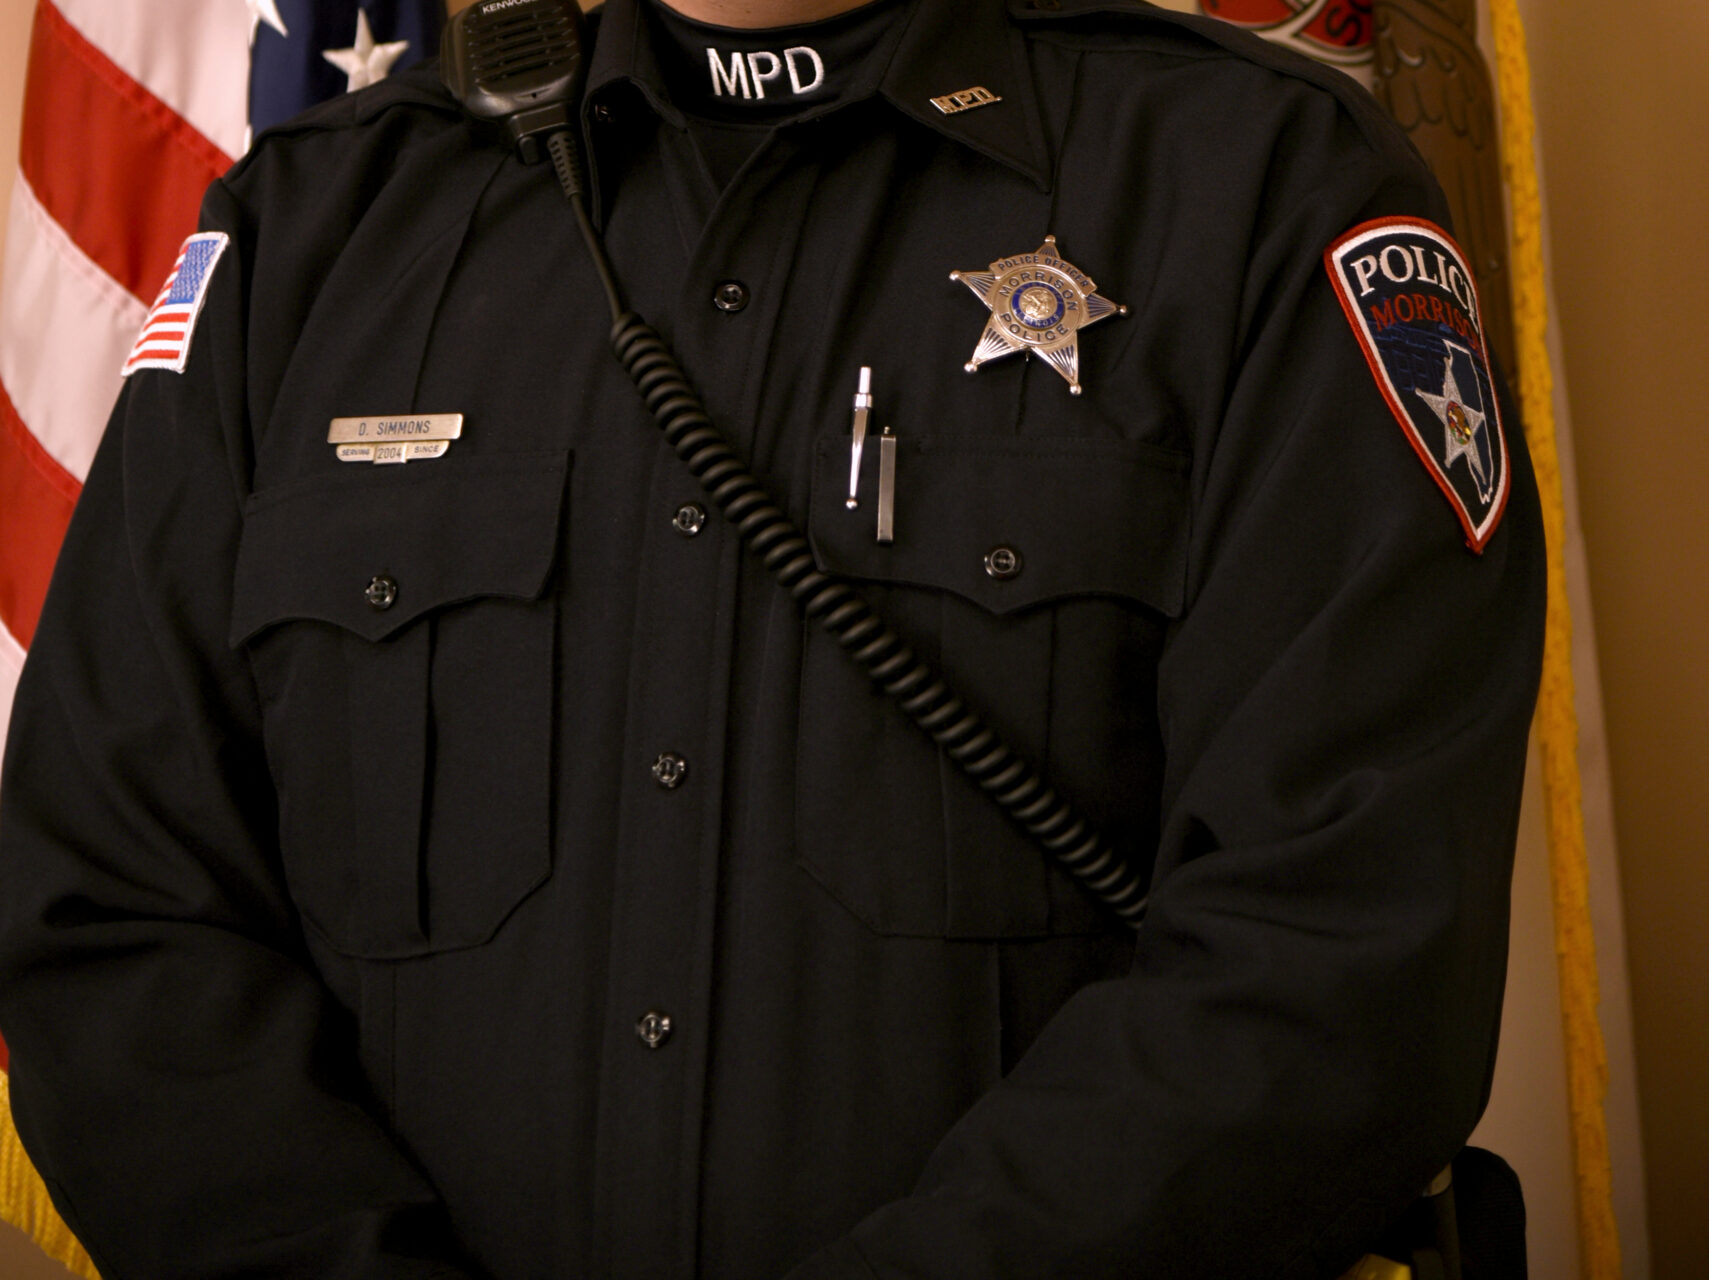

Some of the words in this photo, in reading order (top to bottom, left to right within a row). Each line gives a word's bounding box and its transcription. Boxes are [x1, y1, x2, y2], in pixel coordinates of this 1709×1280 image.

[706, 46, 824, 99] MPD
[998, 255, 1039, 271] POLICE
[1045, 258, 1089, 288] OFFICER
[999, 271, 1078, 312] MORRISON
[1000, 312, 1069, 342] POLICE
[1370, 293, 1482, 357] MORRISO
[376, 420, 431, 436] SIMMONS
[377, 447, 402, 460] 2004
[414, 444, 440, 453] SINCE
